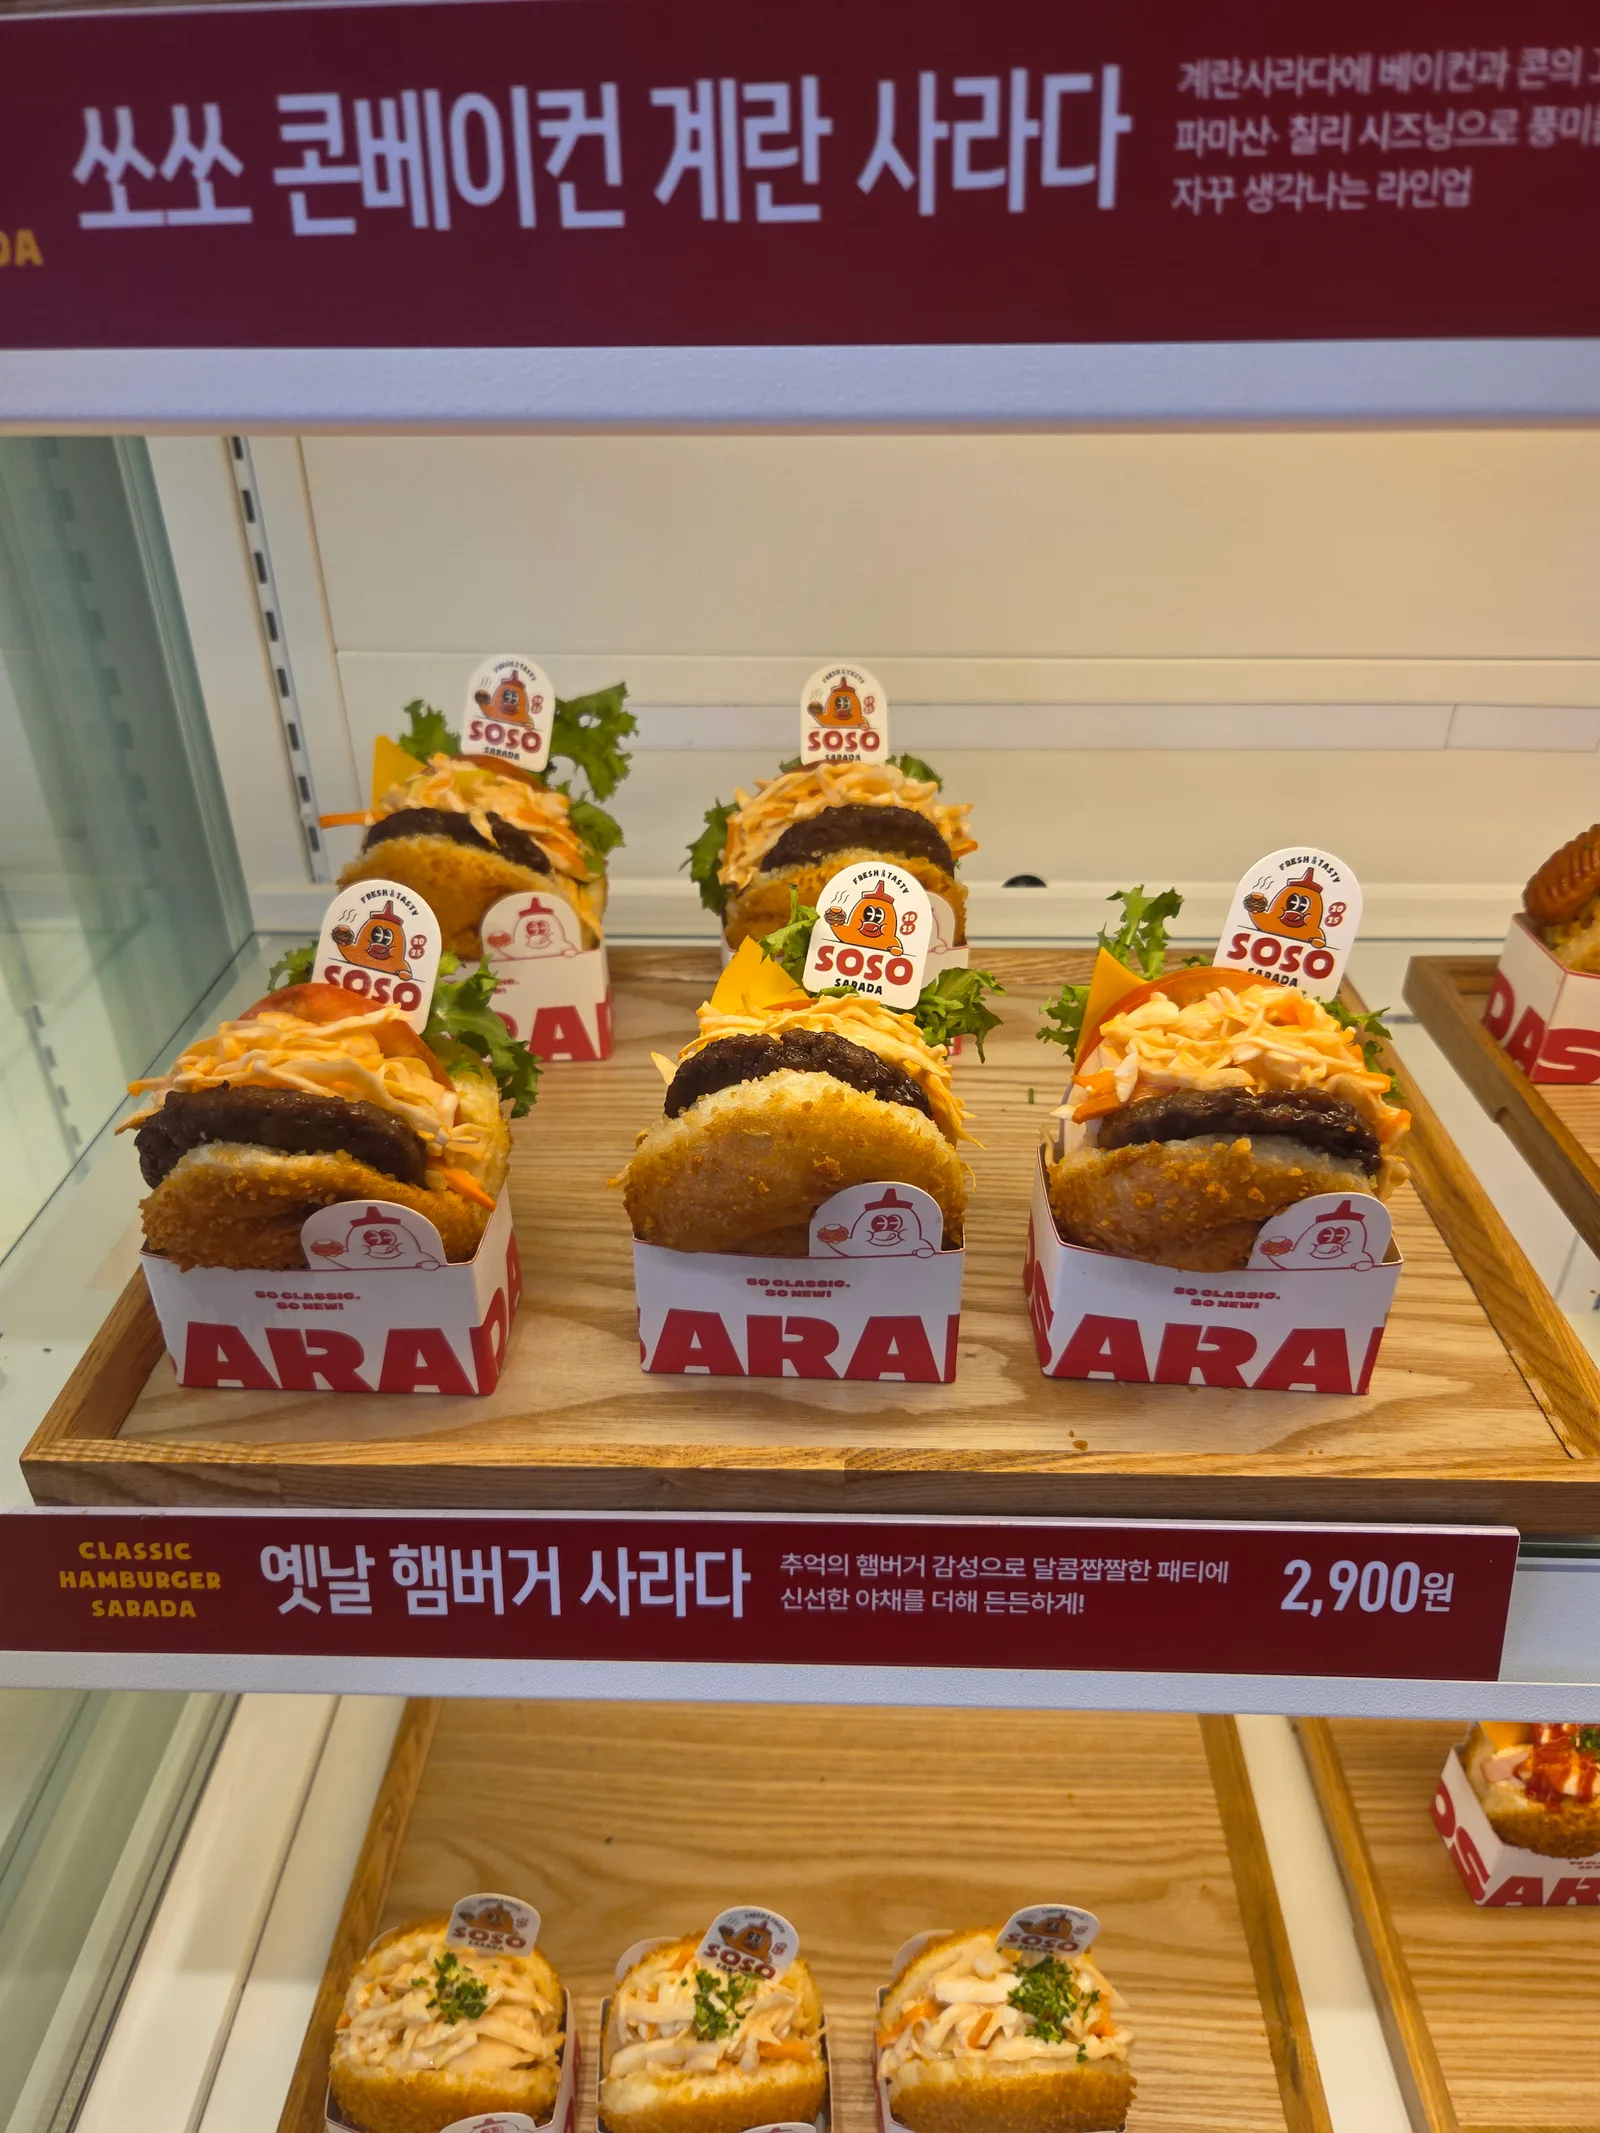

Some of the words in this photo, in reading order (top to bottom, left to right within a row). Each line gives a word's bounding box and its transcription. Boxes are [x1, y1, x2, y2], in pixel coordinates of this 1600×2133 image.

[1176, 52, 1372, 100] 계란사라다에
[1378, 46, 1511, 93] 베이컨과
[1517, 44, 1583, 90] 콘의
[1289, 111, 1350, 156] 칠리
[1357, 106, 1520, 153] 시즈닝으로
[1528, 101, 1600, 149] 풍미
[73, 103, 253, 229] 쏘쏘
[273, 82, 625, 236] 콘베이컨
[650, 75, 833, 223] 계란
[857, 64, 1132, 216] 사라다
[1171, 173, 1237, 217] 자꾸
[1243, 168, 1371, 215] 생각나는
[1376, 164, 1473, 210] 라인업
[468, 720, 543, 754] SOSO
[807, 730, 880, 752] SOSO
[852, 869, 879, 885] FRESH
[887, 871, 909, 894] TASTY
[1279, 856, 1309, 871] FRESH
[1317, 859, 1341, 883] TASTY
[360, 889, 388, 904] FRESH
[396, 891, 419, 917] TASTY
[814, 945, 914, 986] SOSO
[1226, 932, 1335, 980] SOSO
[324, 964, 422, 1012] SOSO
[254, 1290, 279, 1299] SO
[281, 1292, 361, 1300] CLASSIC.
[746, 1277, 770, 1286] SO
[772, 1279, 850, 1288] CLASSIC.
[765, 1289, 788, 1297] SO
[1173, 1286, 1198, 1296] SO
[1200, 1289, 1280, 1300] CLASSIC.
[276, 1301, 300, 1310] SO
[1190, 1298, 1214, 1307] SO
[1217, 1300, 1260, 1309] NEW!
[78, 1541, 192, 1561] CLASSIC
[59, 1570, 221, 1590] HAMBURGER
[260, 1544, 375, 1615] 옛날
[389, 1545, 560, 1616] 햄버거
[579, 1547, 752, 1619] 사라다
[779, 1552, 849, 1577] 추억의
[855, 1553, 926, 1578] 햄버거
[932, 1555, 1027, 1579] 감성으로
[1032, 1557, 1152, 1582] 달콤짭짤한
[1156, 1559, 1230, 1584] 패티에
[780, 1587, 851, 1611] 신선한
[855, 1587, 926, 1612] 야채를
[931, 1588, 978, 1613] 더해
[983, 1590, 1085, 1615] 든든하게!
[1280, 1559, 1455, 1618] 2,900원
[91, 1599, 197, 1618] SARADA
[453, 1926, 527, 1949] SOSO
[1004, 1932, 1079, 1952] SOSO
[703, 1942, 776, 1980] SOSO
